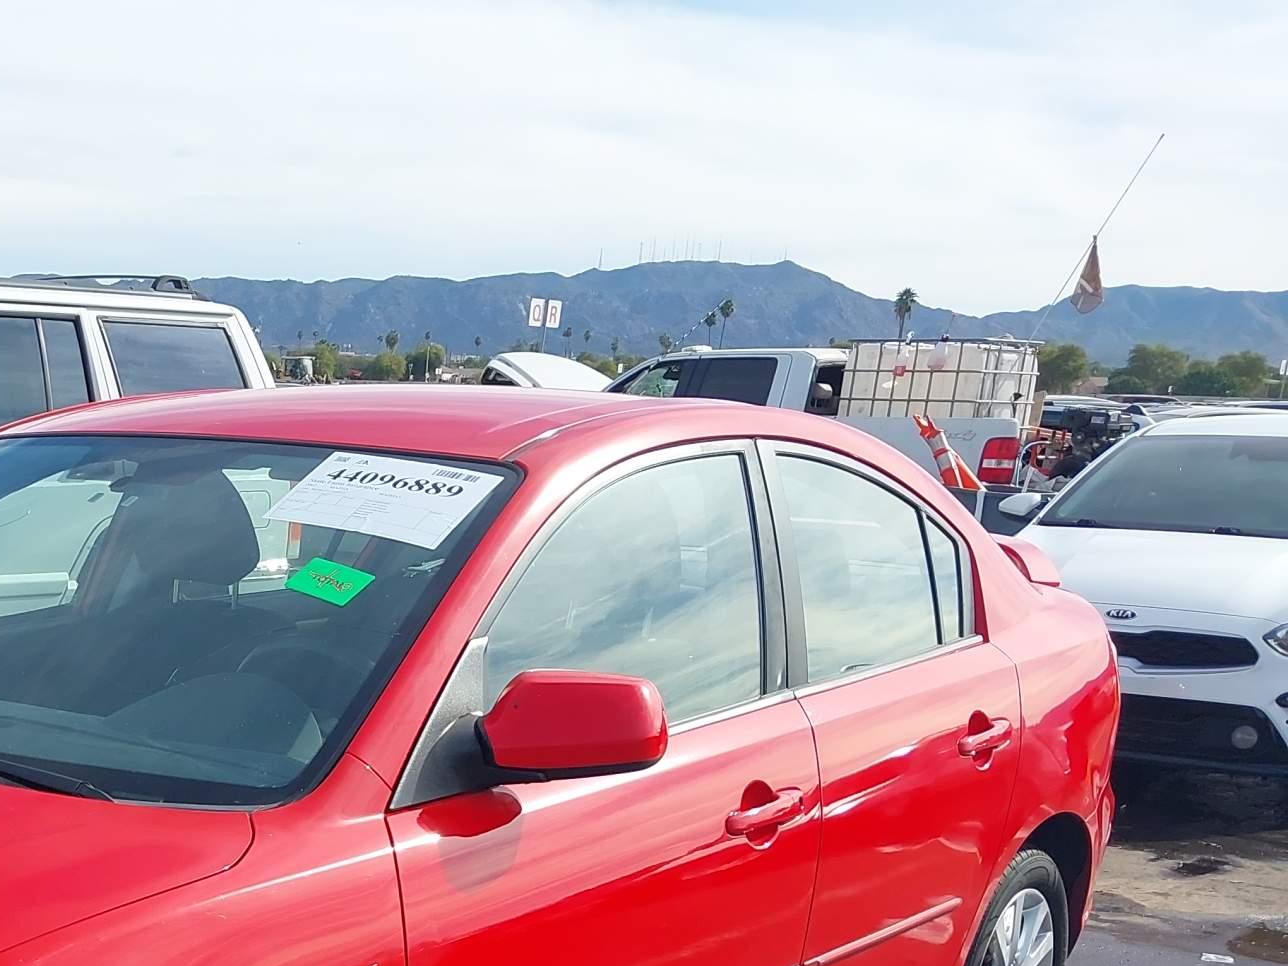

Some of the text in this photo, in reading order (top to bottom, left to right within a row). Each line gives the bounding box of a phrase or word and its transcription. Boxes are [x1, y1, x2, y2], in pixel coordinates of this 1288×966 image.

[533, 304, 558, 324] Q R
[327, 468, 464, 498] 44096889
[1109, 609, 1132, 618] KIA
